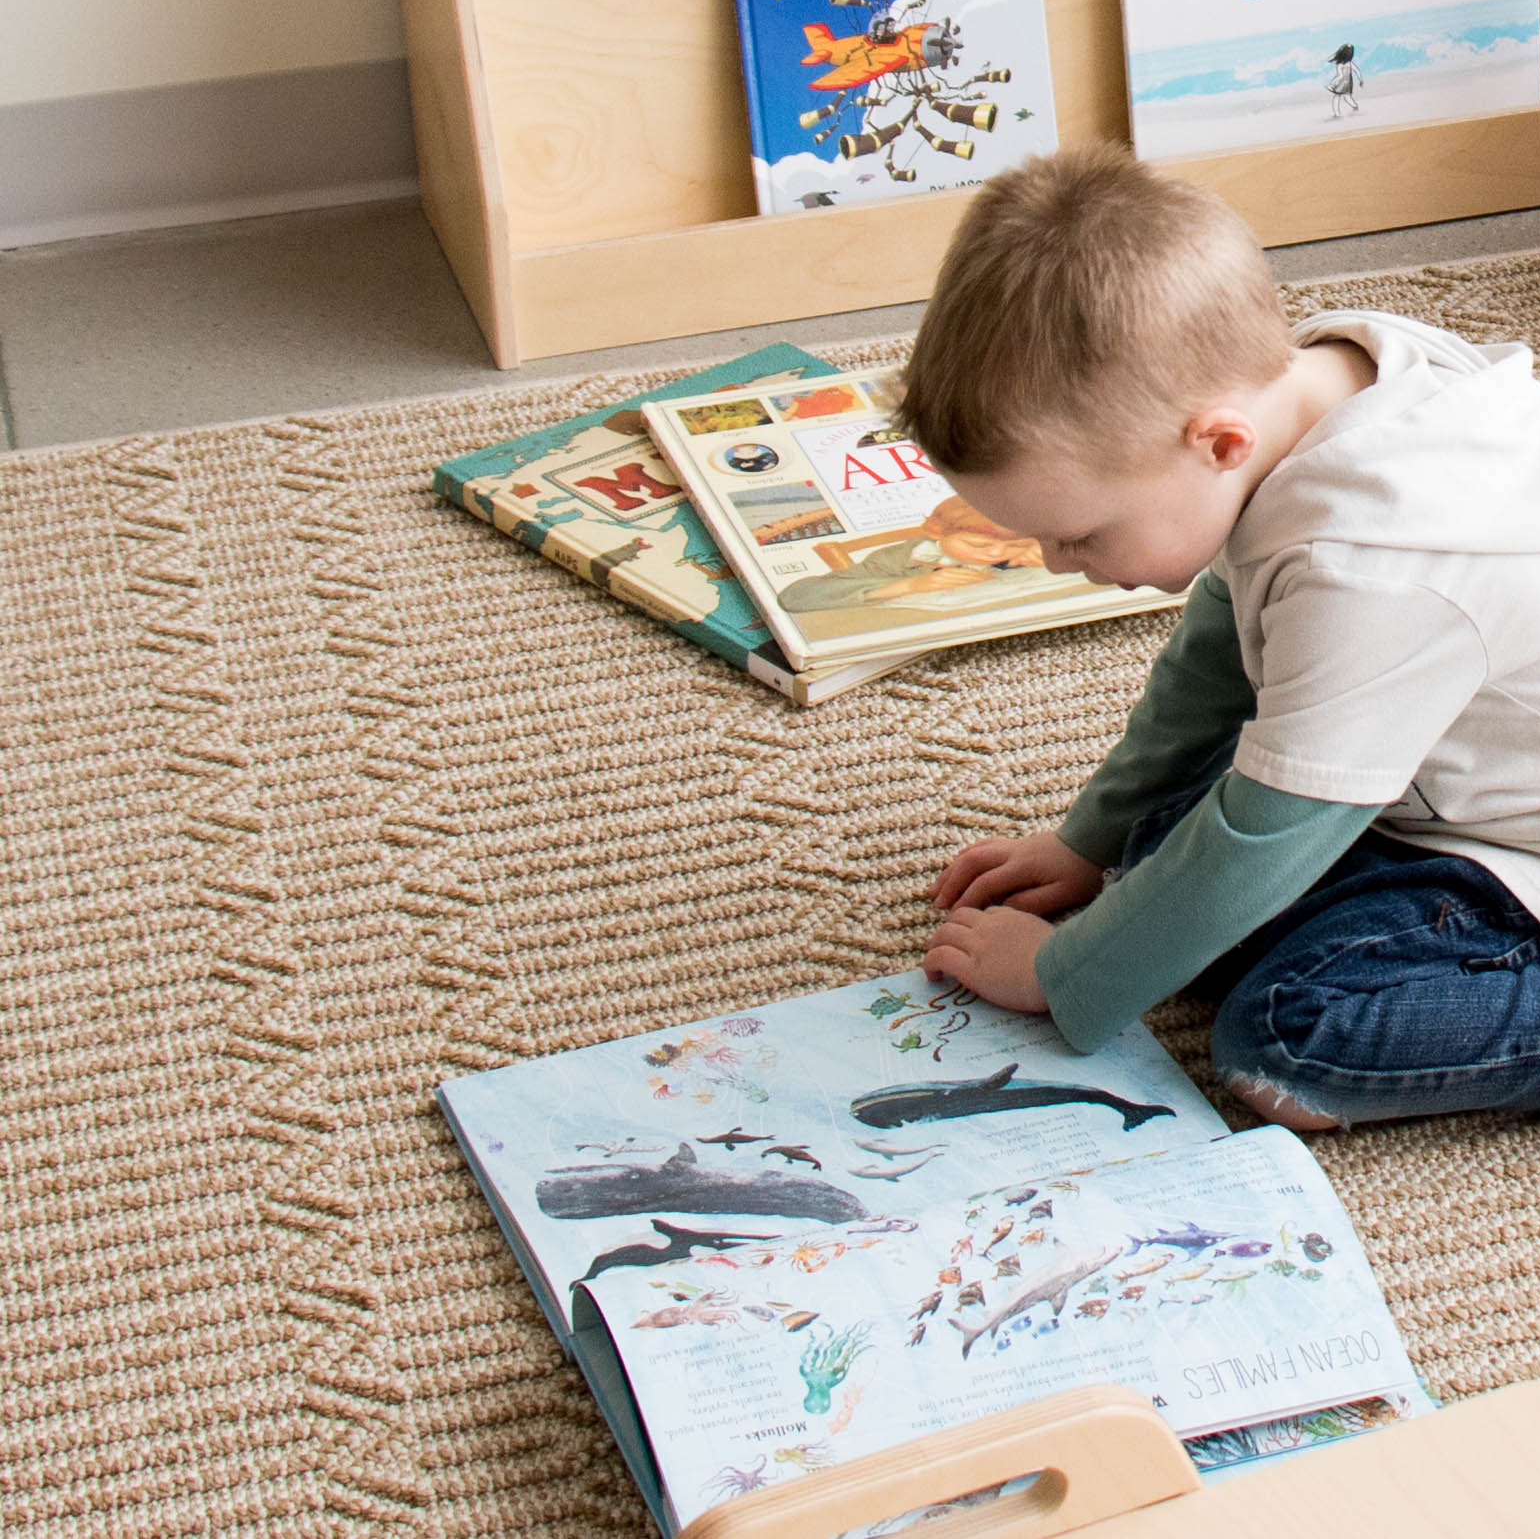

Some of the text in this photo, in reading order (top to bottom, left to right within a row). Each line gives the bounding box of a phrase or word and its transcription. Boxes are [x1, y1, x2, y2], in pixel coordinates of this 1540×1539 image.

[839, 444, 938, 492] AR
[1277, 1183, 1303, 1195] Fish
[1183, 1330, 1380, 1399] OCEAN FAMILIES
[744, 1420, 807, 1441] Mollusks
